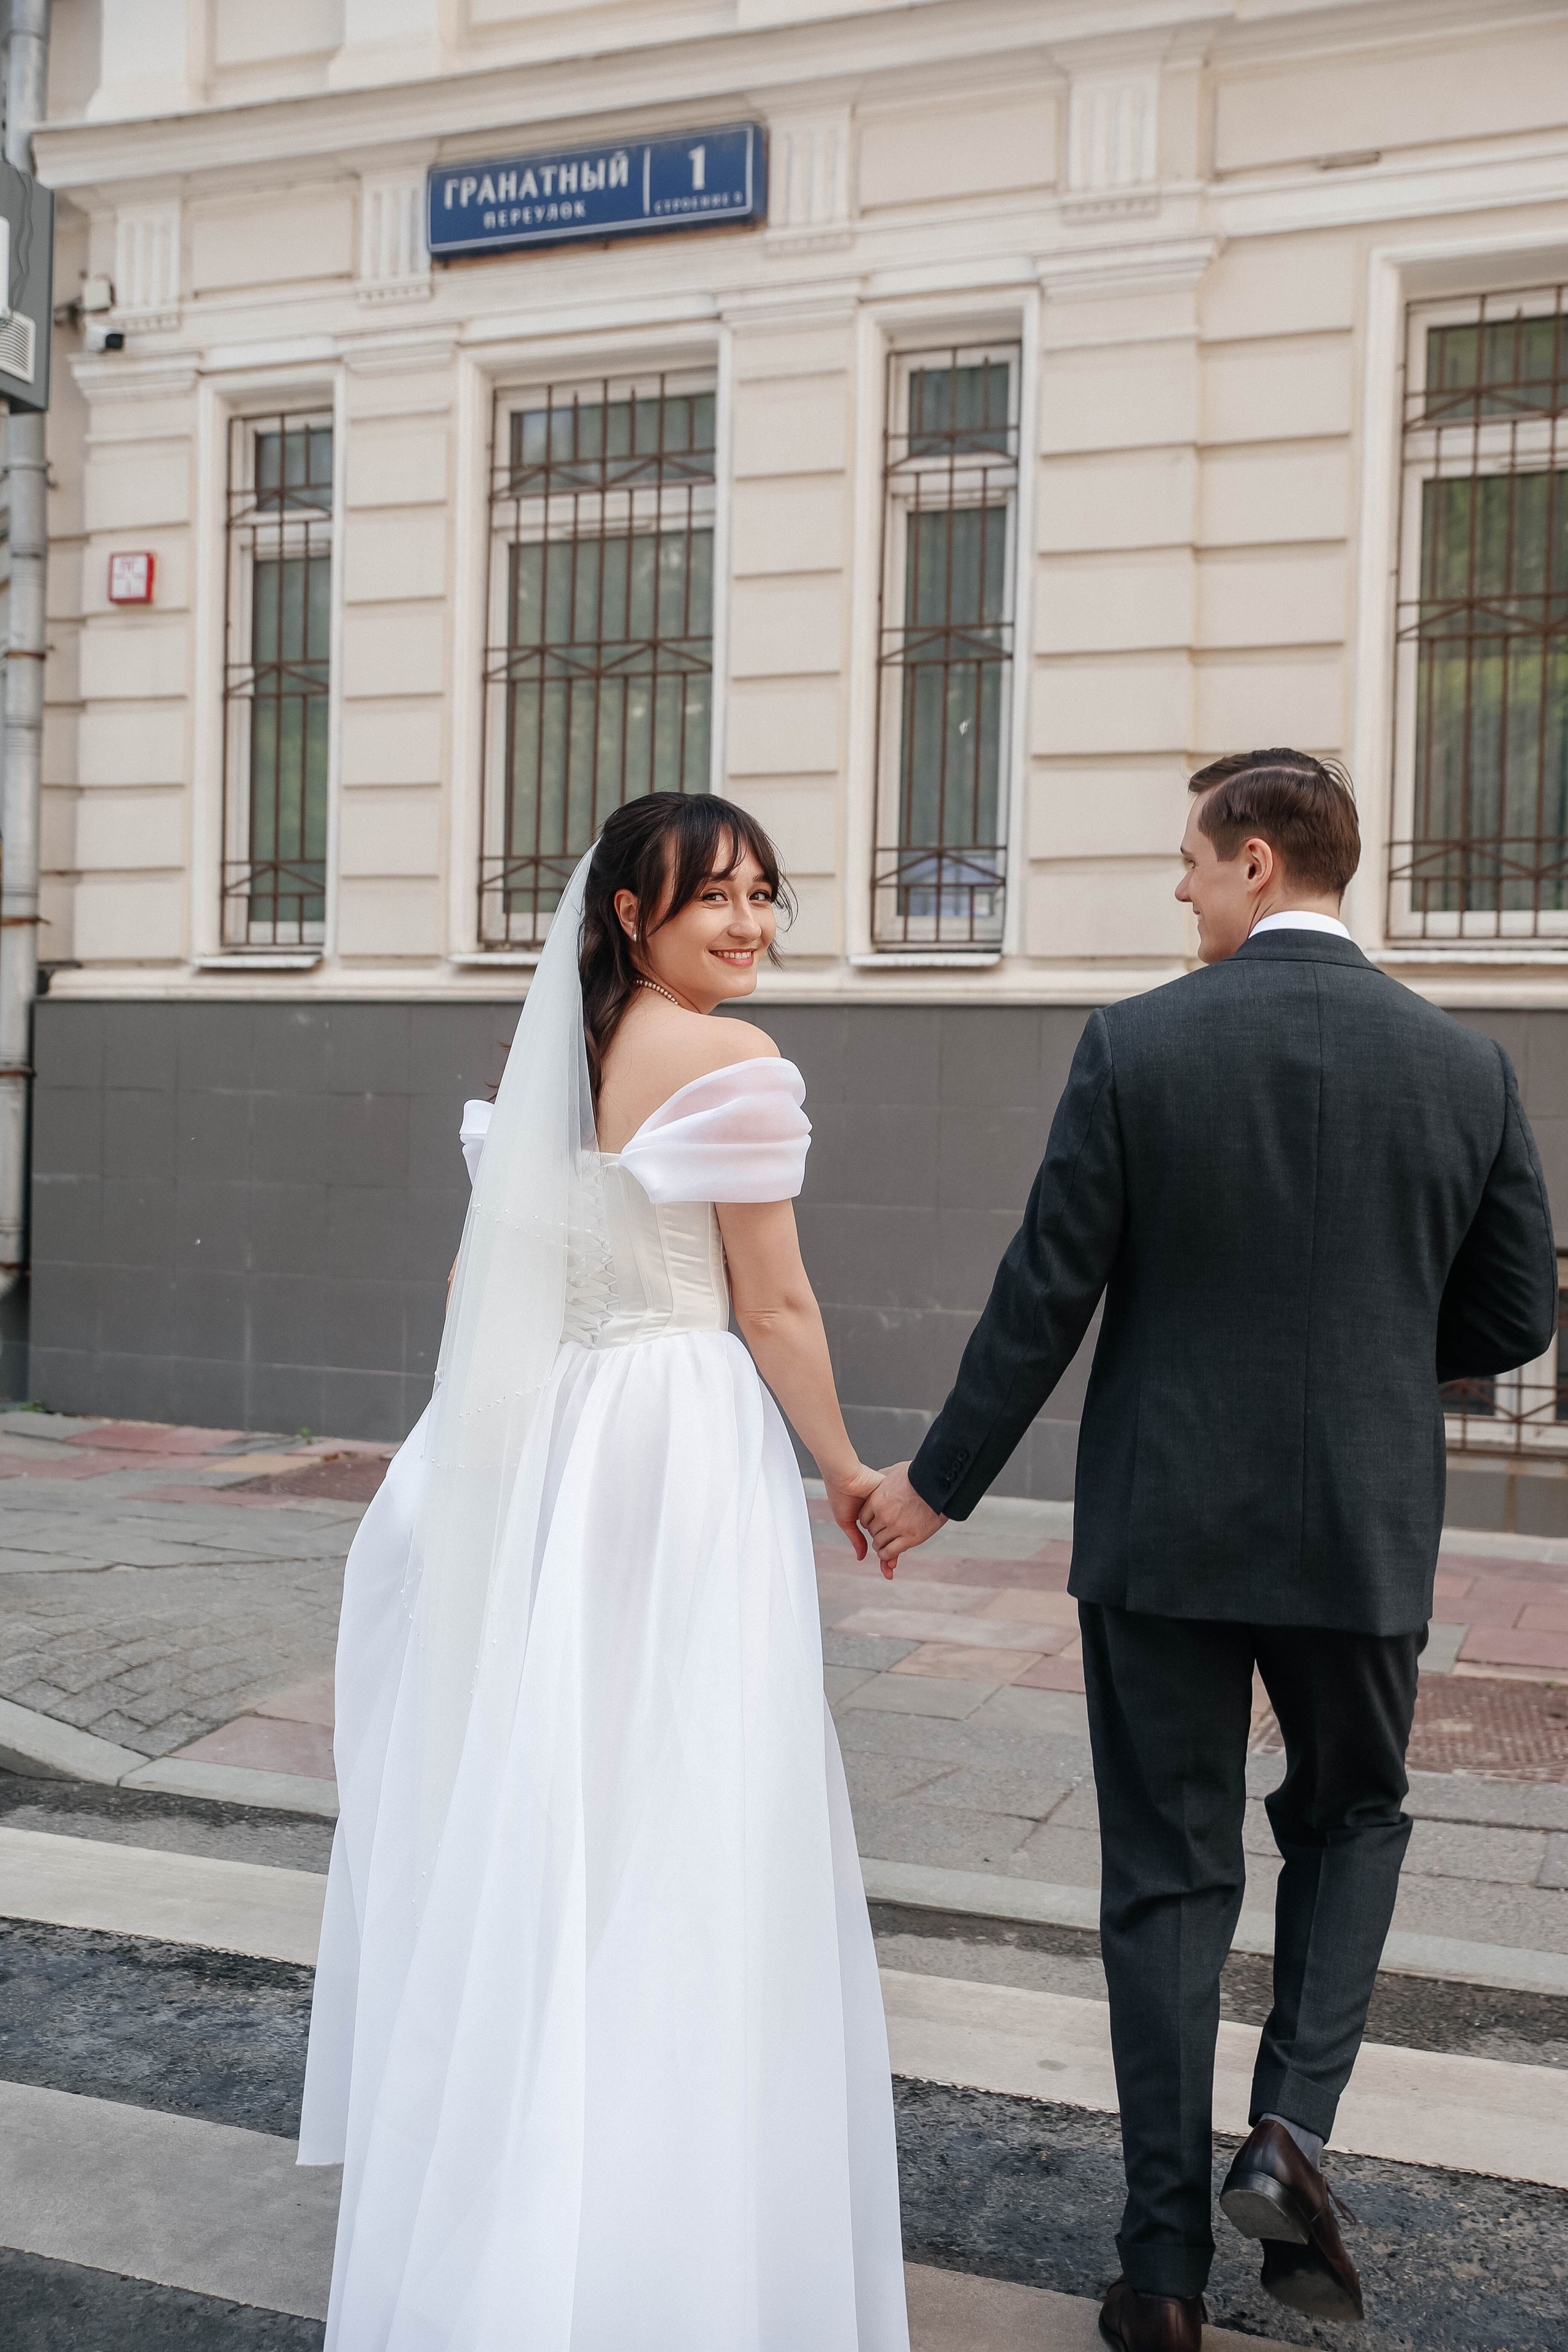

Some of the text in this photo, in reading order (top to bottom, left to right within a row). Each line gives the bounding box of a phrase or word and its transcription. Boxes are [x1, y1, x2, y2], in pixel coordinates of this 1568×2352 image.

[443, 151, 629, 210] ГРАНАТНЫЙ
[688, 144, 706, 191] 1
[483, 199, 586, 230] ПЕРЕУЛОК
